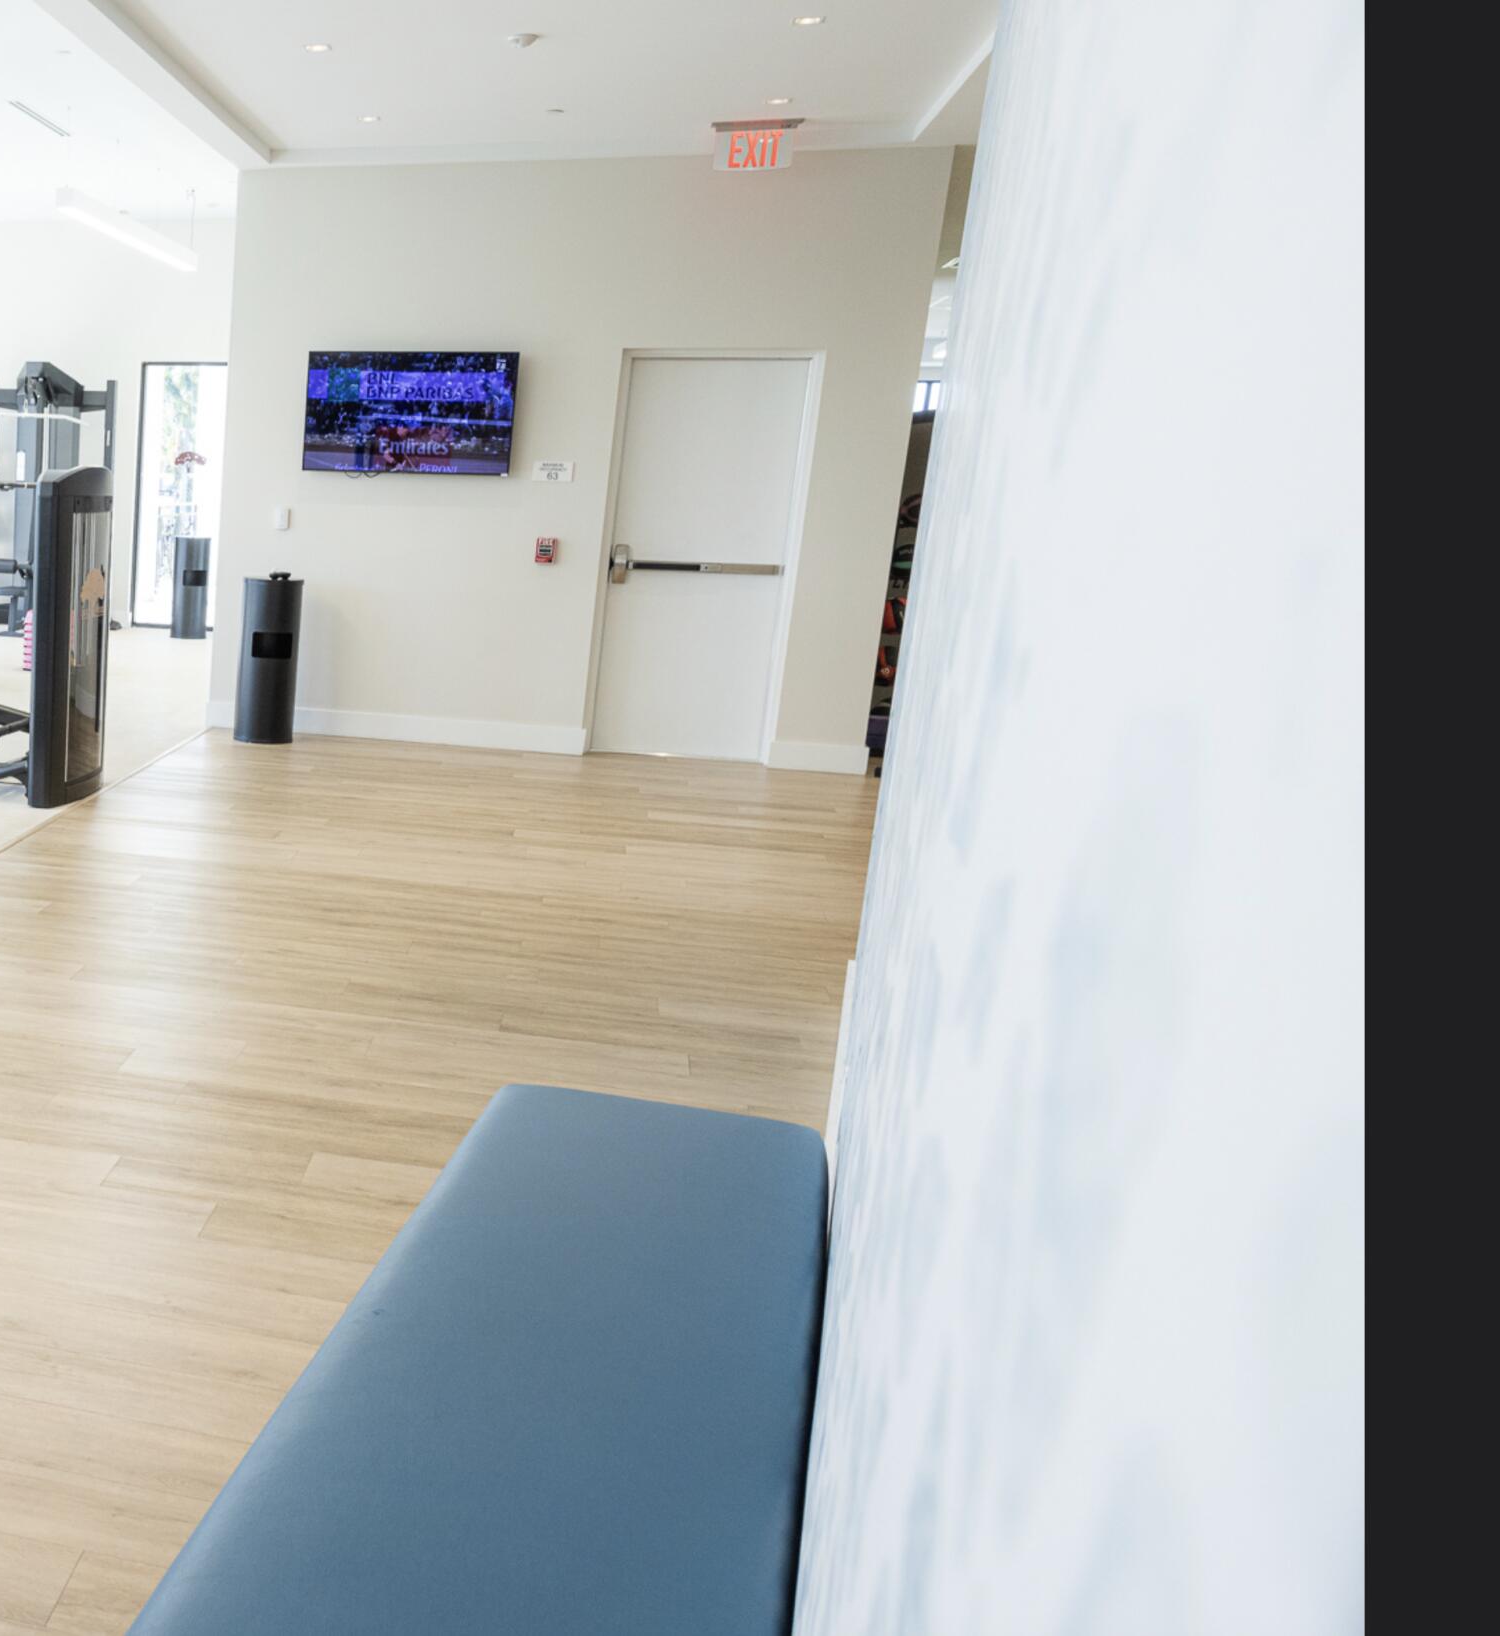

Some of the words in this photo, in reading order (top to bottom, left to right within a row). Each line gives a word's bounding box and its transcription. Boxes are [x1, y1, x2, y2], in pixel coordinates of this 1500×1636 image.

[727, 129, 784, 168] EXIT
[366, 385, 400, 399] BNP
[404, 386, 475, 400] PARIBAS
[378, 437, 450, 456] Emirates
[546, 471, 559, 481] 63
